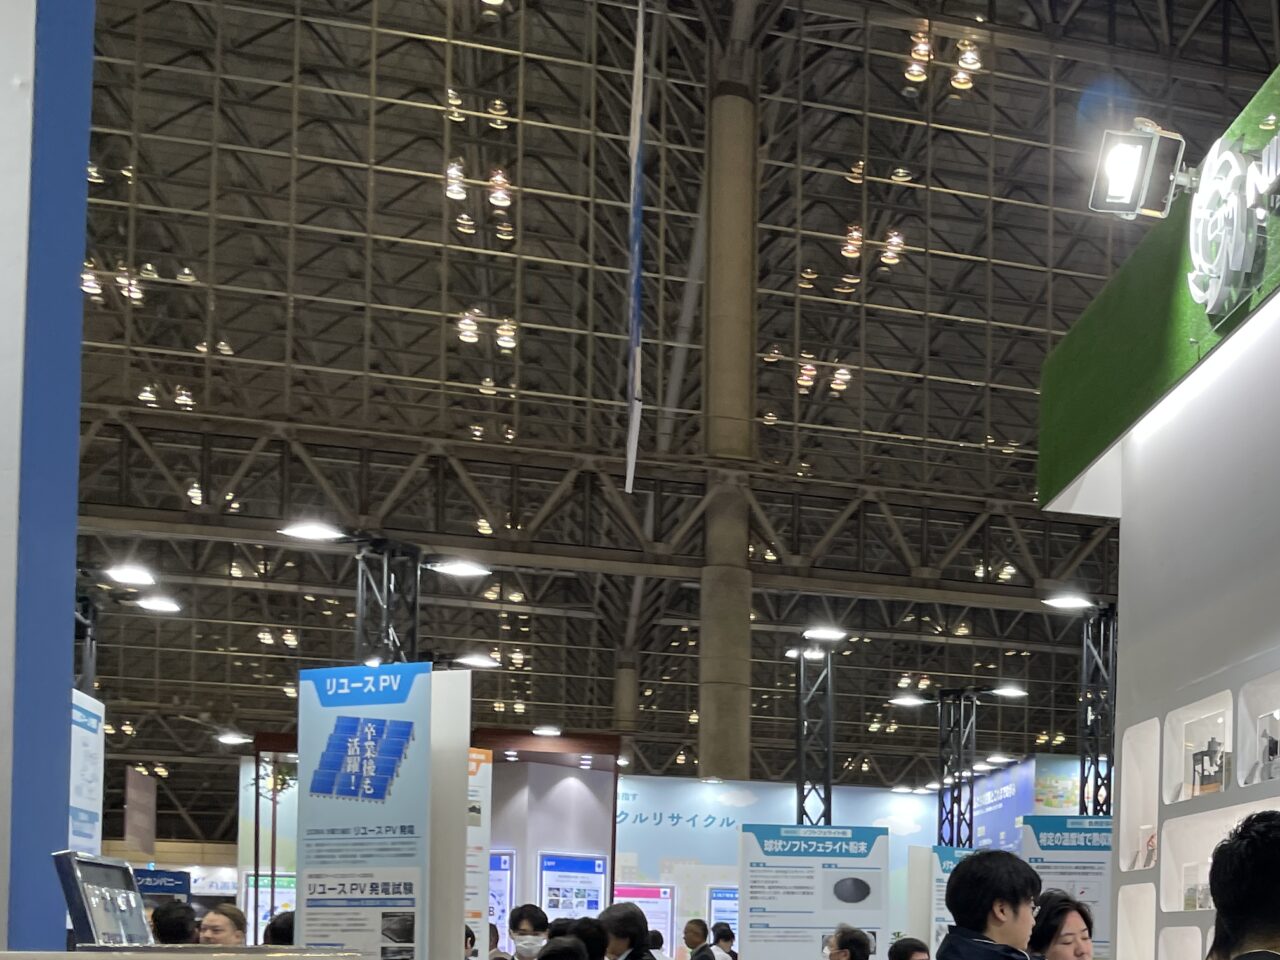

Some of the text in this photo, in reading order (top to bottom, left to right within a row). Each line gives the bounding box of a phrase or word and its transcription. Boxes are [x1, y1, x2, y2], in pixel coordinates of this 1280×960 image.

[326, 674, 401, 695] リユース PV
[354, 826, 383, 836] リユース
[385, 825, 397, 835] PV
[308, 882, 414, 895] リユース PV 発電試験
